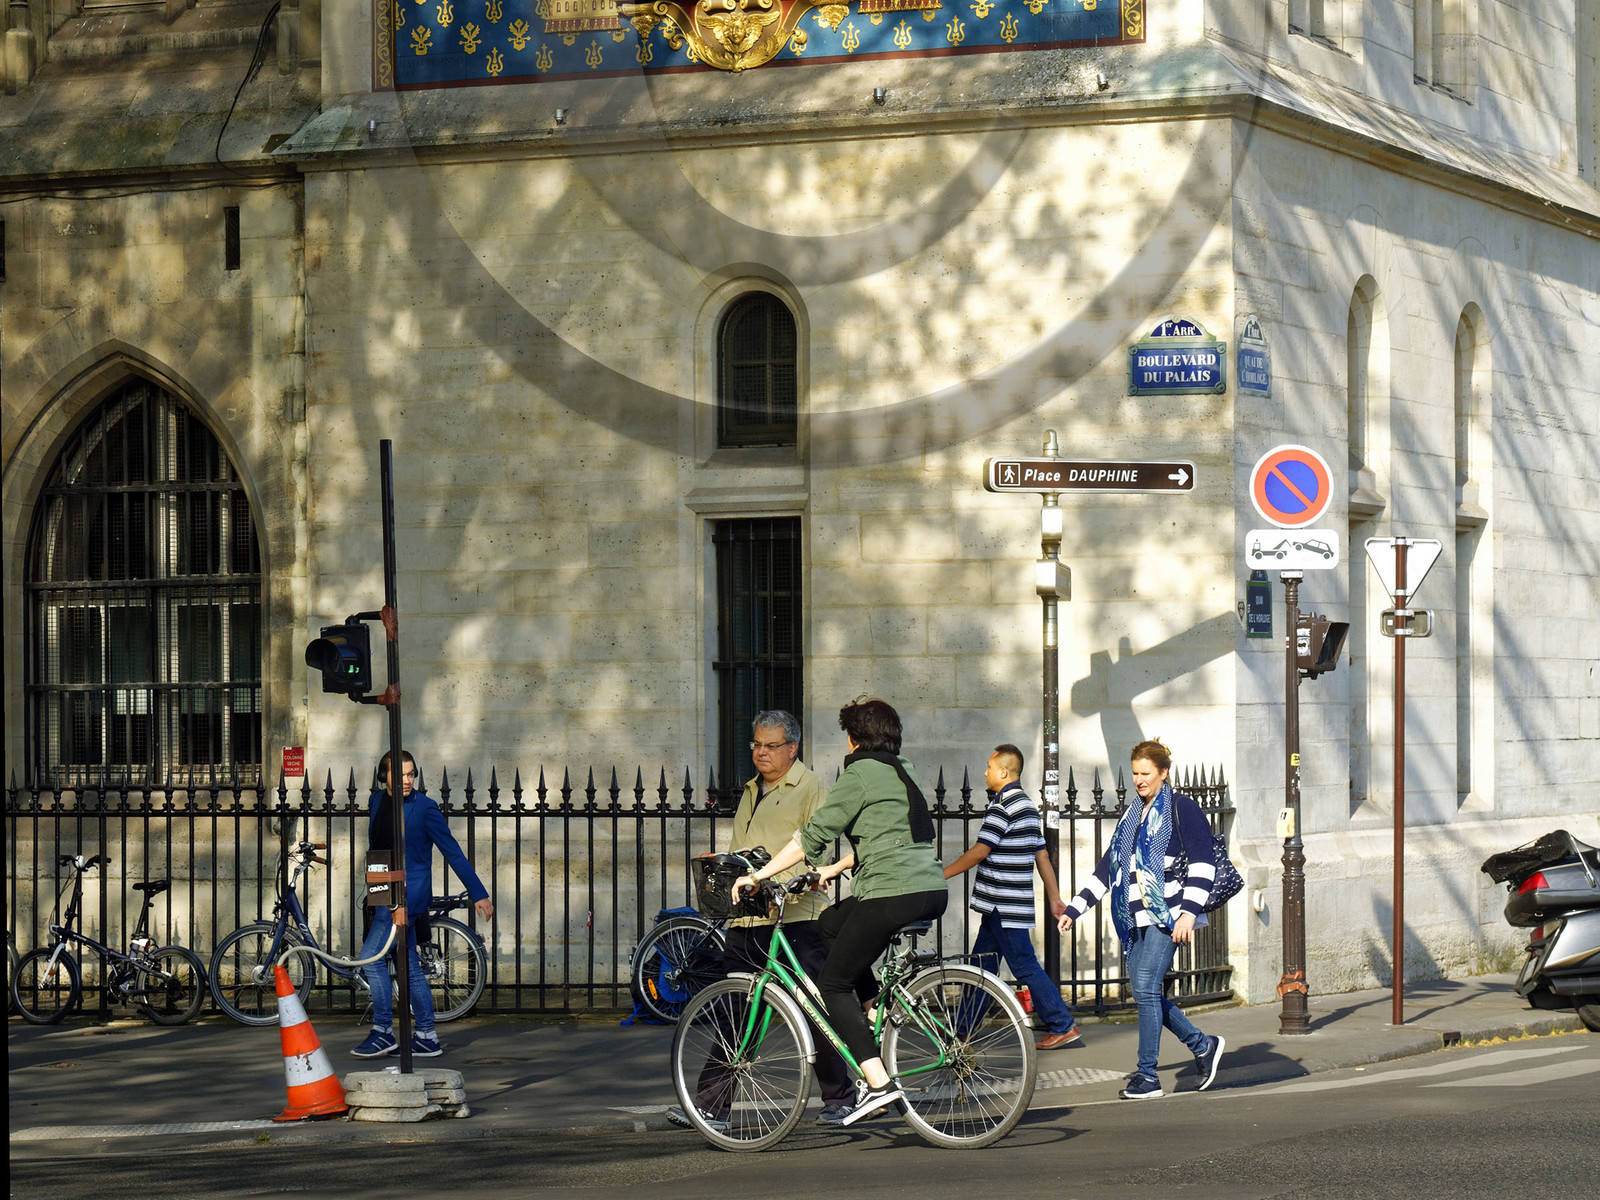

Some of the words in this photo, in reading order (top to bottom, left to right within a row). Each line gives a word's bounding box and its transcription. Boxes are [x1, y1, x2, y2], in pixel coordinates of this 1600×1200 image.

[1138, 354, 1216, 367] BOULEVARD
[1144, 371, 1162, 383] DU
[1165, 370, 1211, 383] PALAIS
[1024, 468, 1061, 482] Place
[1068, 469, 1138, 482] DAUPHINE
